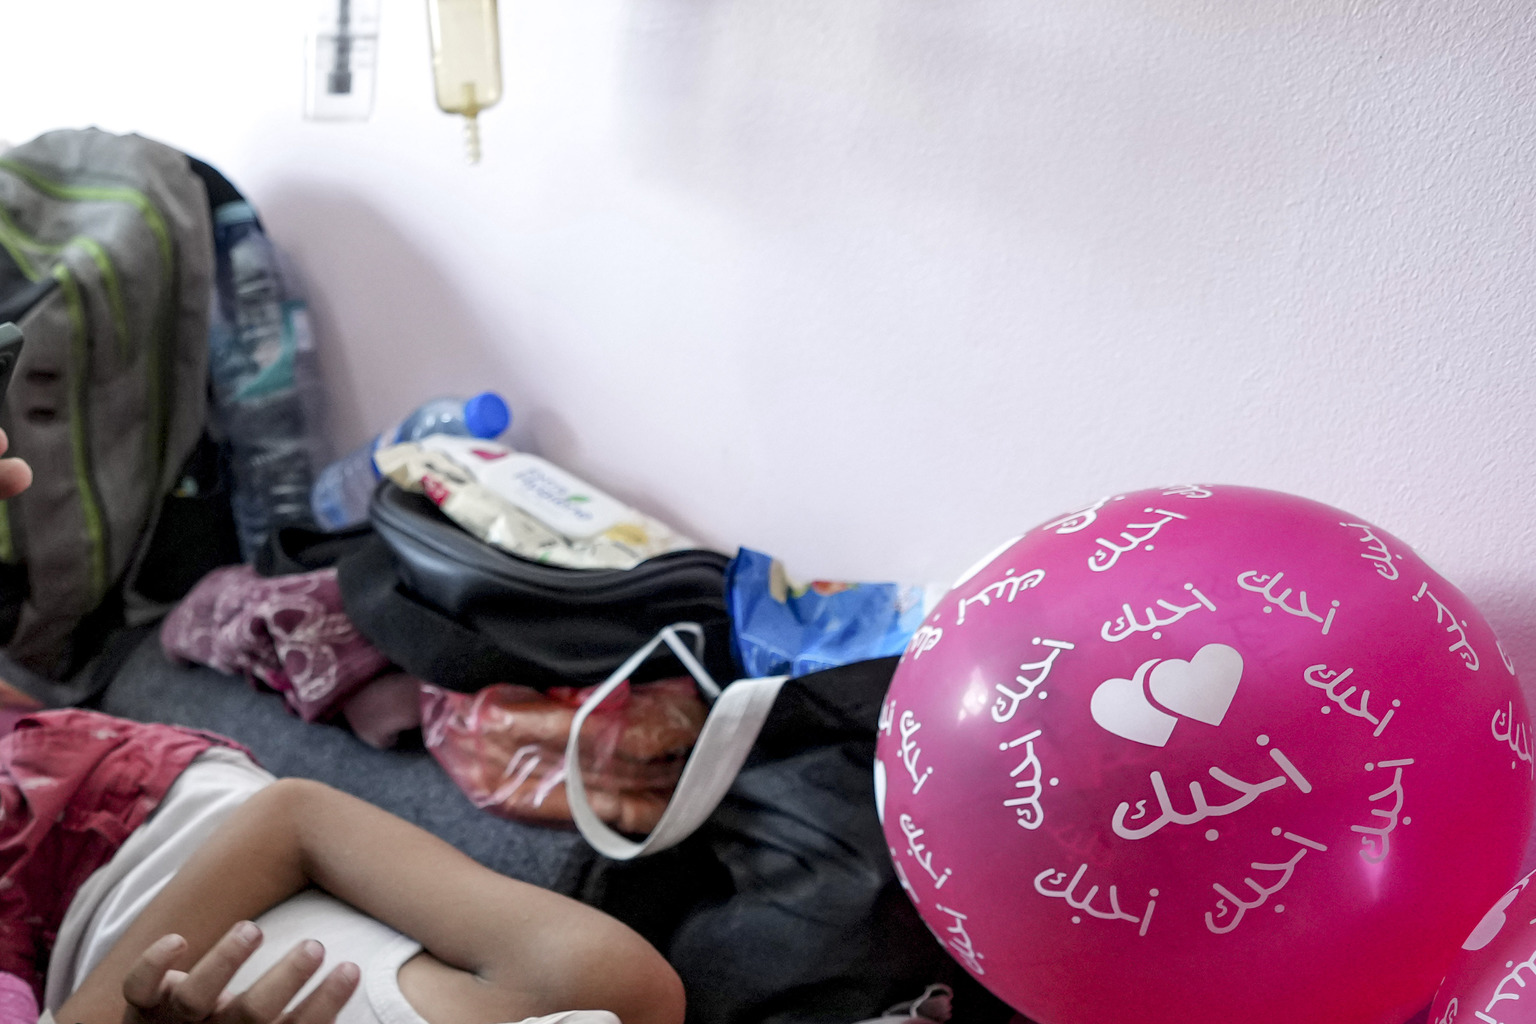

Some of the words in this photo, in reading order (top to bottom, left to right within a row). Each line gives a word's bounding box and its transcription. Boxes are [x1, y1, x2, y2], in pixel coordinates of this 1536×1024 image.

[1087, 507, 1189, 572] أحبك
[1338, 521, 1404, 581] أحبك
[955, 567, 1047, 627] أحبك
[1100, 582, 1219, 643] أحبك
[1236, 569, 1341, 636] أحبك
[1410, 580, 1480, 672] أحبك
[990, 636, 1076, 724] أحبك
[1303, 663, 1402, 738] أحبك
[896, 709, 934, 796] أحبك
[998, 727, 1061, 831] أحبك
[1110, 733, 1313, 841] أحبك
[1350, 757, 1416, 864] أحبك
[899, 812, 953, 891] أحبك
[1204, 826, 1329, 935] أحبك
[1033, 862, 1161, 938] أحبك
